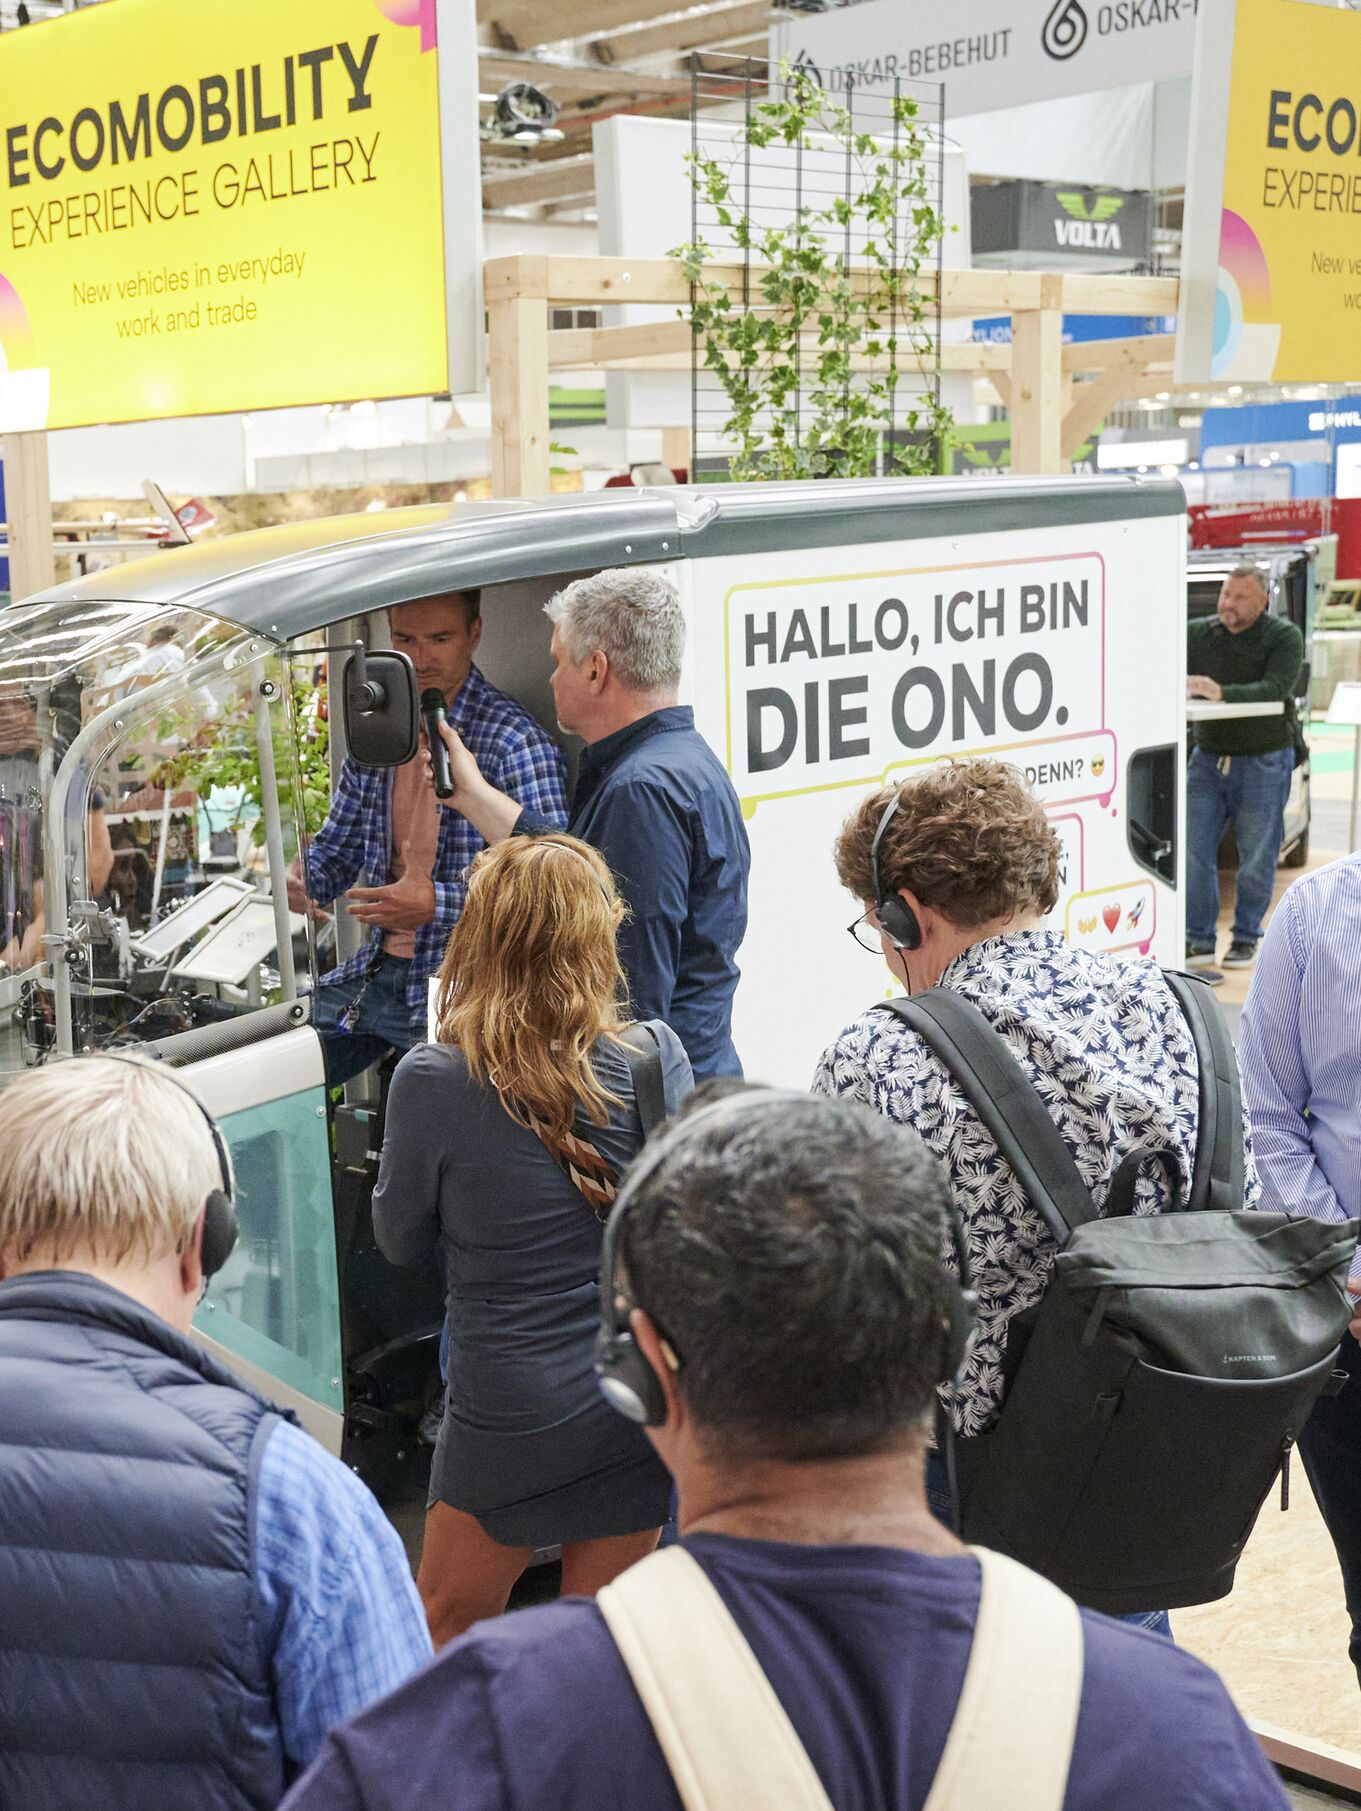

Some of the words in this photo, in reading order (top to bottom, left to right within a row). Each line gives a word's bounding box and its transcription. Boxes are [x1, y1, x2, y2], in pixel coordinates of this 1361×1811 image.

[1097, 0, 1198, 36] OSKAR-
[829, 28, 1013, 92] OSKAR-BEBEHUT
[6, 34, 381, 188] ECOMOBILITY
[1266, 89, 1361, 156] ECO
[10, 171, 200, 249] EXPERIENCE
[213, 132, 382, 209] GALLERY
[1054, 219, 1122, 250] VOLTA
[1311, 251, 1344, 275] New
[73, 281, 112, 306] New
[117, 263, 189, 299] vehicles
[194, 262, 211, 288] in
[217, 247, 306, 287] everyday
[117, 309, 161, 338] work
[166, 302, 200, 332] and
[207, 295, 257, 327] trade
[745, 597, 920, 667] HALLO,
[934, 588, 1005, 644] ICH
[1019, 580, 1089, 635] BIN
[746, 674, 871, 773] DIE
[891, 652, 1069, 750] ONO.
[1025, 759, 1084, 786] DENN?
